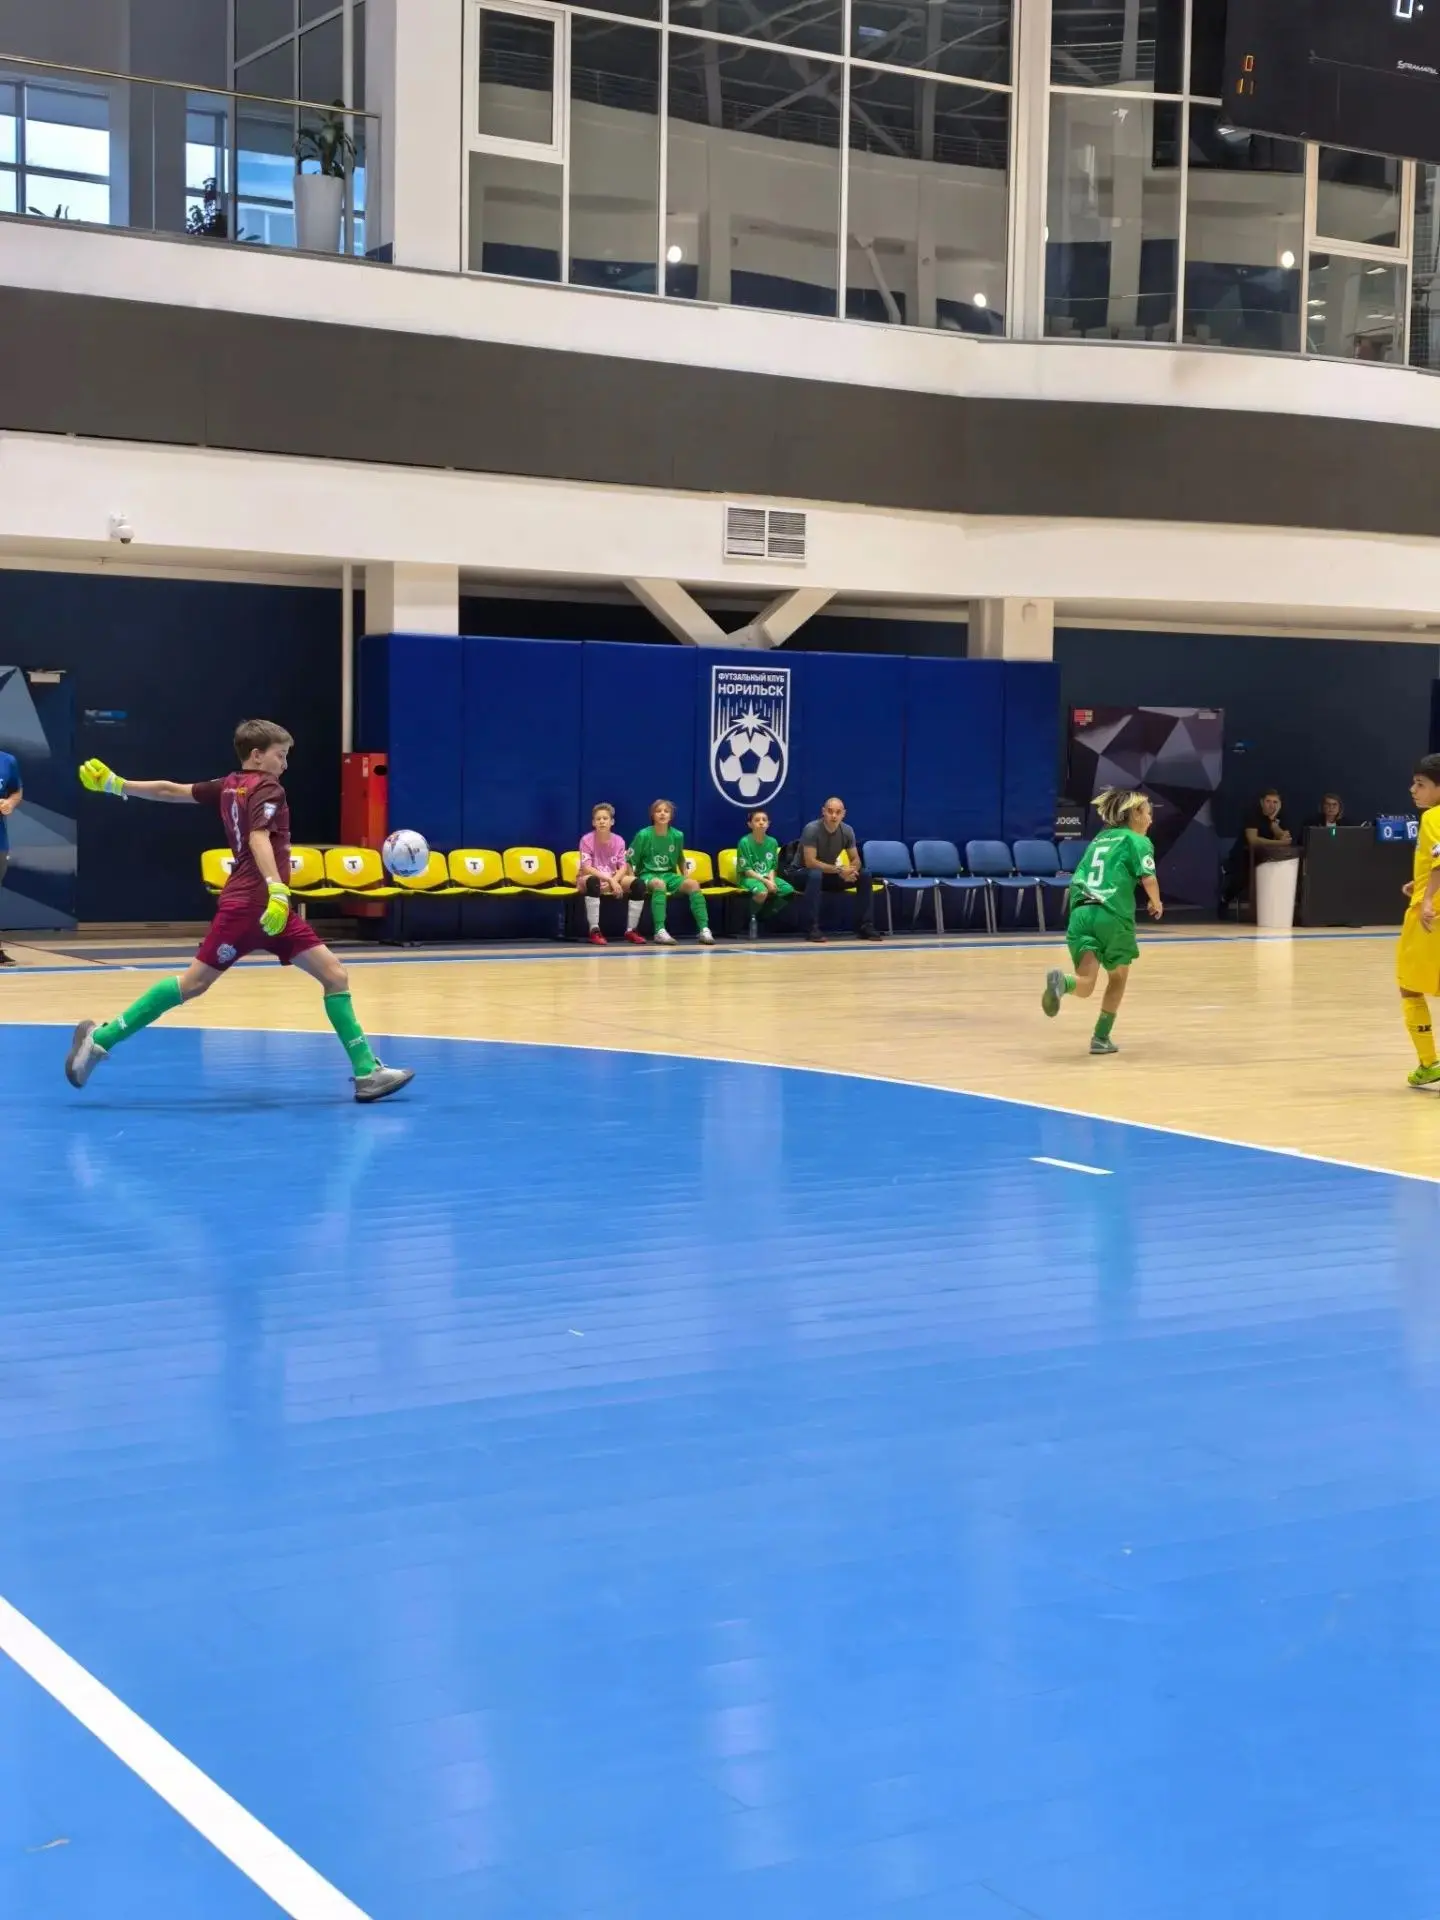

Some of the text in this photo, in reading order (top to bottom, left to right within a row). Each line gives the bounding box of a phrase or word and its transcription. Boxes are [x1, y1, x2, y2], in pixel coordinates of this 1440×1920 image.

[718, 672, 785, 683] ФУТЗАЛЬНЫЙ КЛУБ
[717, 683, 784, 697] НОРИЛЬСК
[1086, 845, 1111, 889] 5
